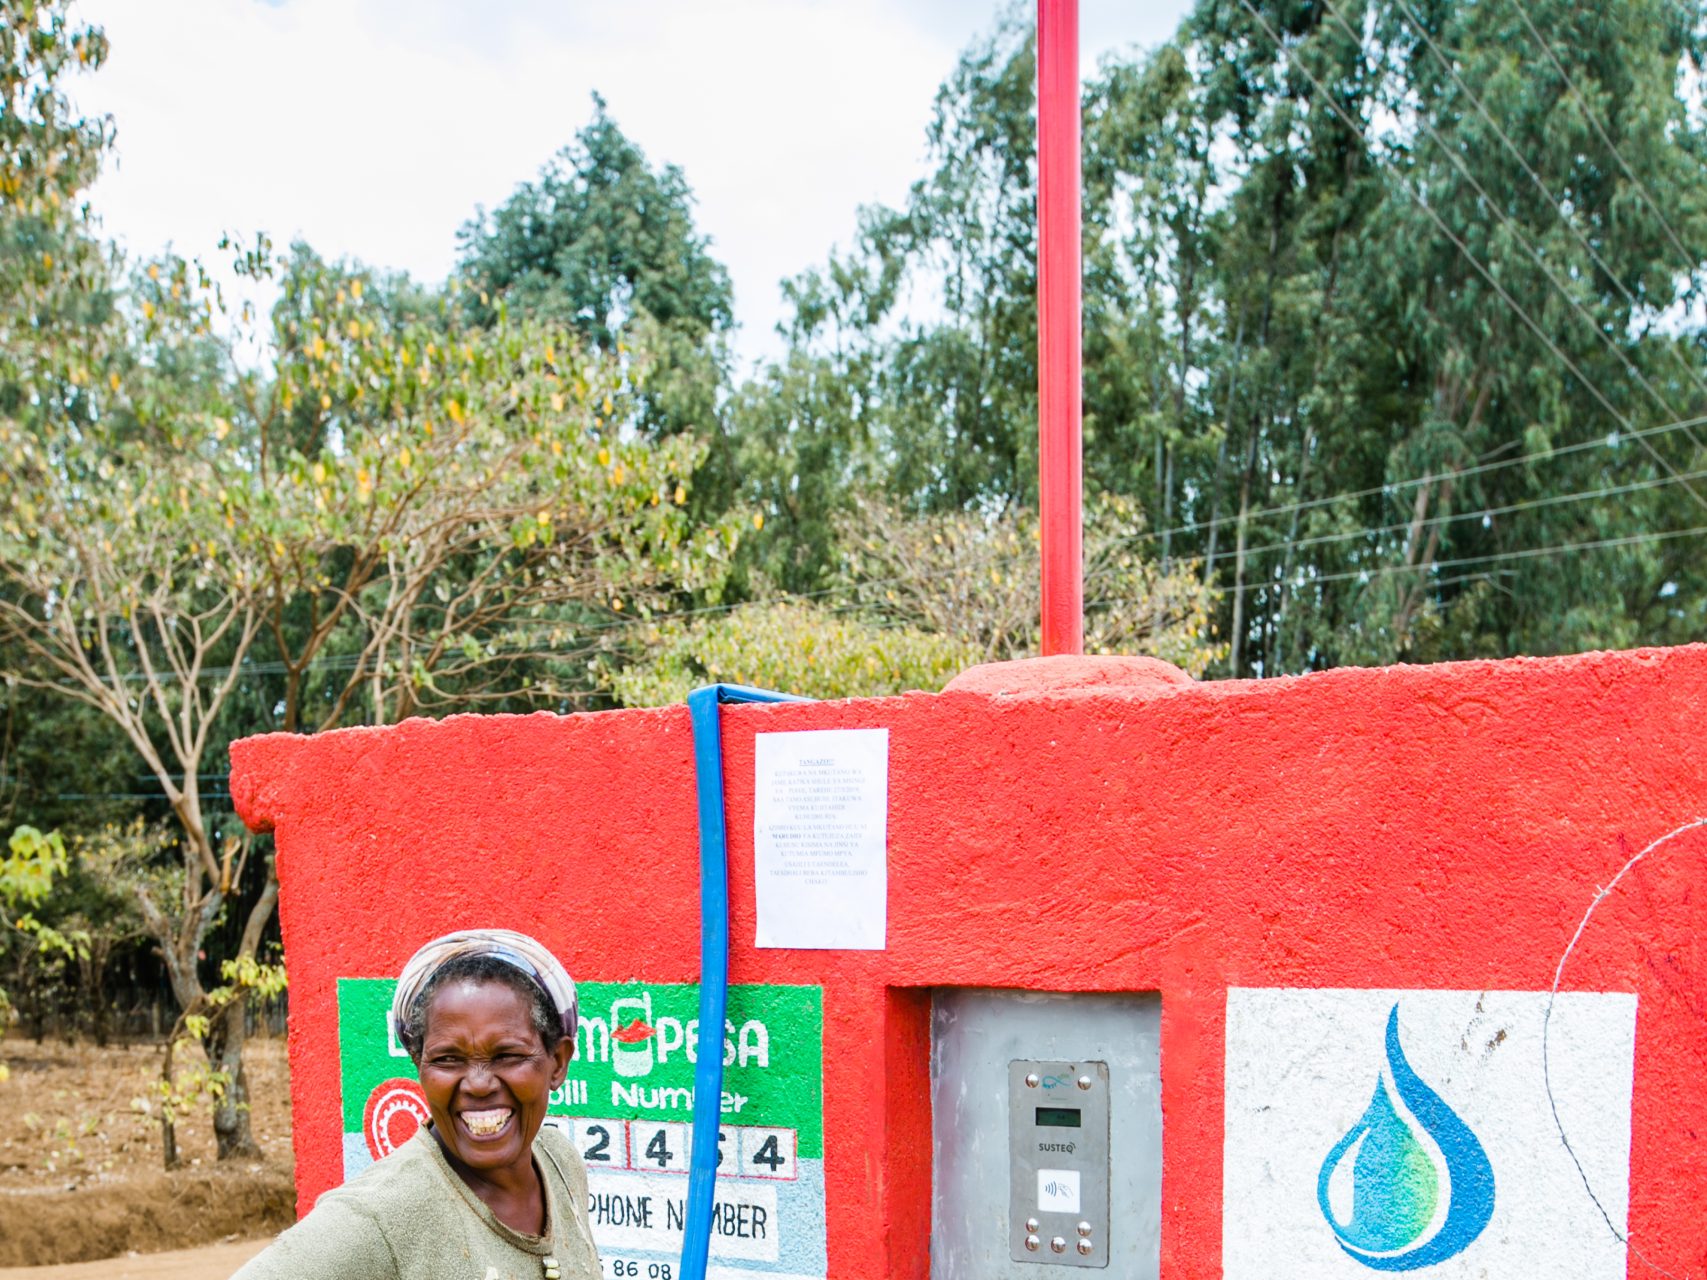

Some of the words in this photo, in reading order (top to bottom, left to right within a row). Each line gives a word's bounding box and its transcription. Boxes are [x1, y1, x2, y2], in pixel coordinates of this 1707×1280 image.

[611, 1080, 748, 1113] Numer
[586, 1125, 610, 1161] 2
[646, 1129, 673, 1167] 4
[752, 1134, 785, 1171] 4
[1038, 1142, 1074, 1155] SUSTEQ
[613, 1259, 638, 1277] 86
[648, 1263, 671, 1280] 08
